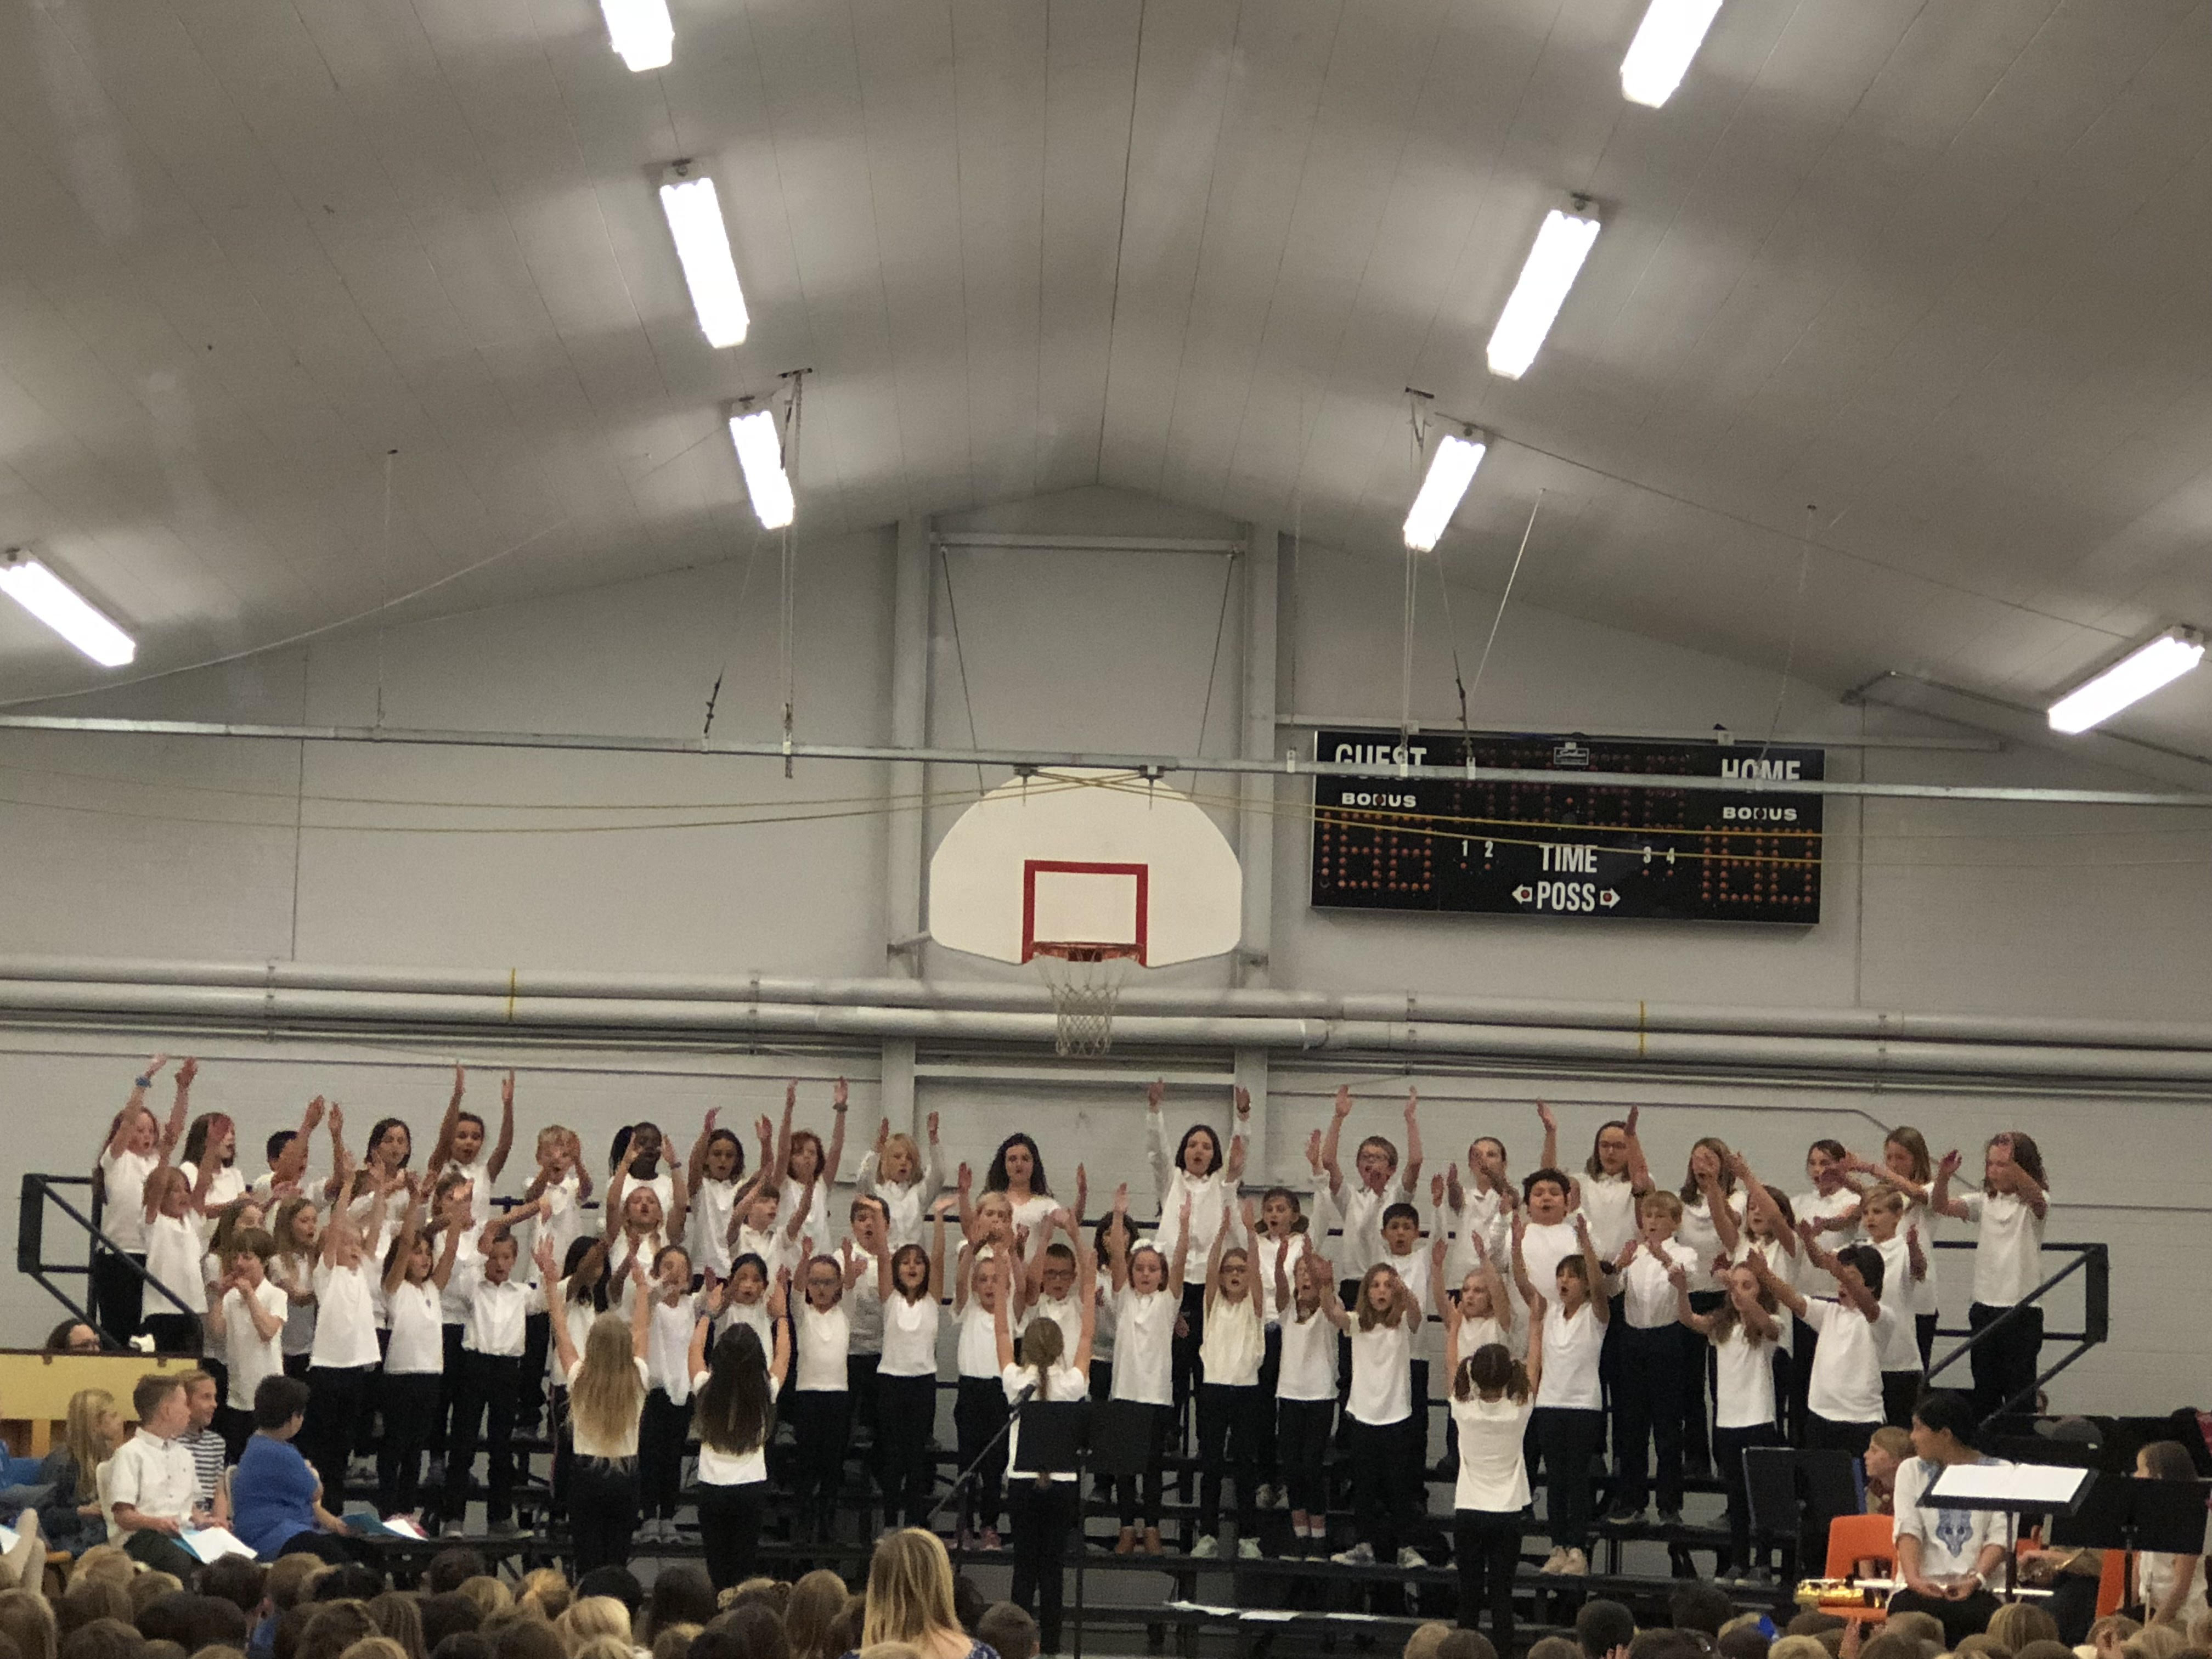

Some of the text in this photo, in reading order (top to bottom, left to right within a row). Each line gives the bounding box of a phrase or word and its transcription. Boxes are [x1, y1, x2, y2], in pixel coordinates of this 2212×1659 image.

[1722, 759, 1801, 786] HOME
[1342, 793, 1416, 808] BONUS
[1723, 806, 1797, 821] BONUS
[1462, 840, 1493, 857] 1 2
[1643, 847, 1675, 864] 3 4
[1539, 845, 1598, 873] TIME
[1537, 881, 1595, 912] POSS
